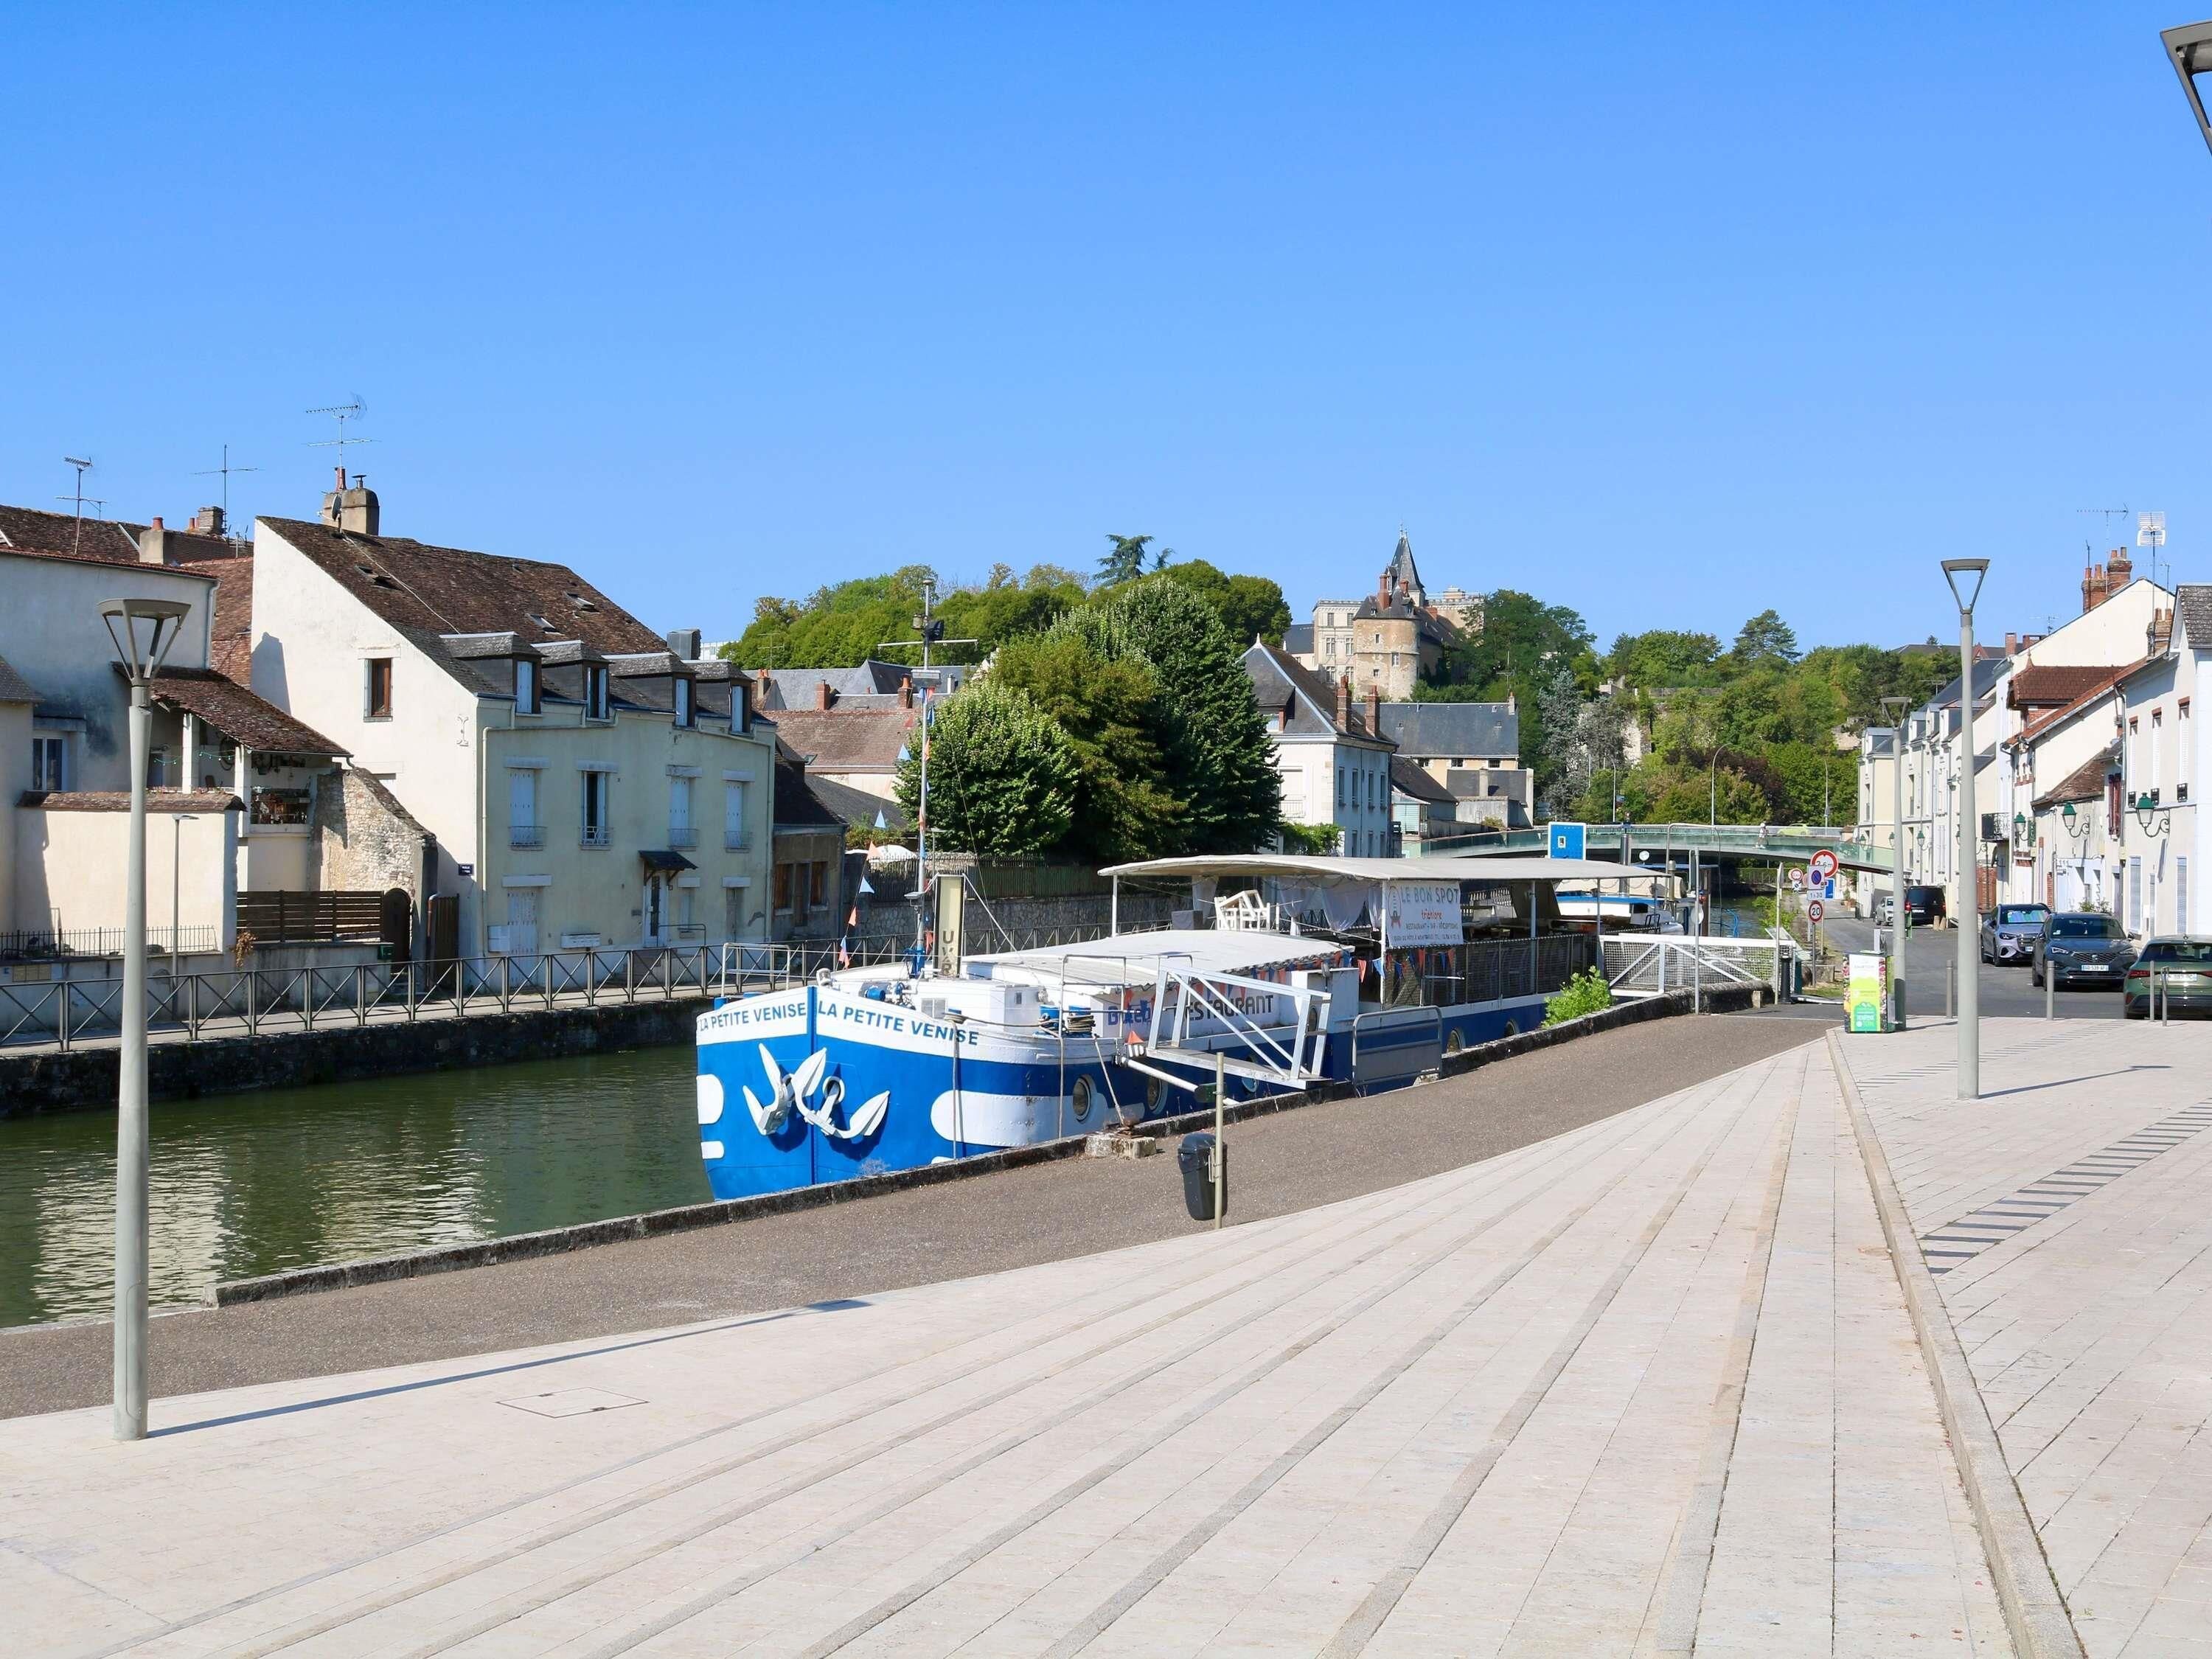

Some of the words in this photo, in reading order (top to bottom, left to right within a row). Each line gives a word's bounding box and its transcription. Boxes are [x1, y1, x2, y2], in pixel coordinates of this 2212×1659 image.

[1401, 886, 1411, 903] LE
[1414, 887, 1433, 903] BON
[1435, 887, 1458, 904] SPOT
[1812, 908, 1820, 916] 20
[700, 1018, 709, 1031] LA
[712, 1011, 749, 1029] PETITE
[754, 1003, 807, 1022] VENISE
[818, 1001, 838, 1018] LA
[844, 1006, 905, 1032] PETITE
[911, 1020, 980, 1046] VENISE
